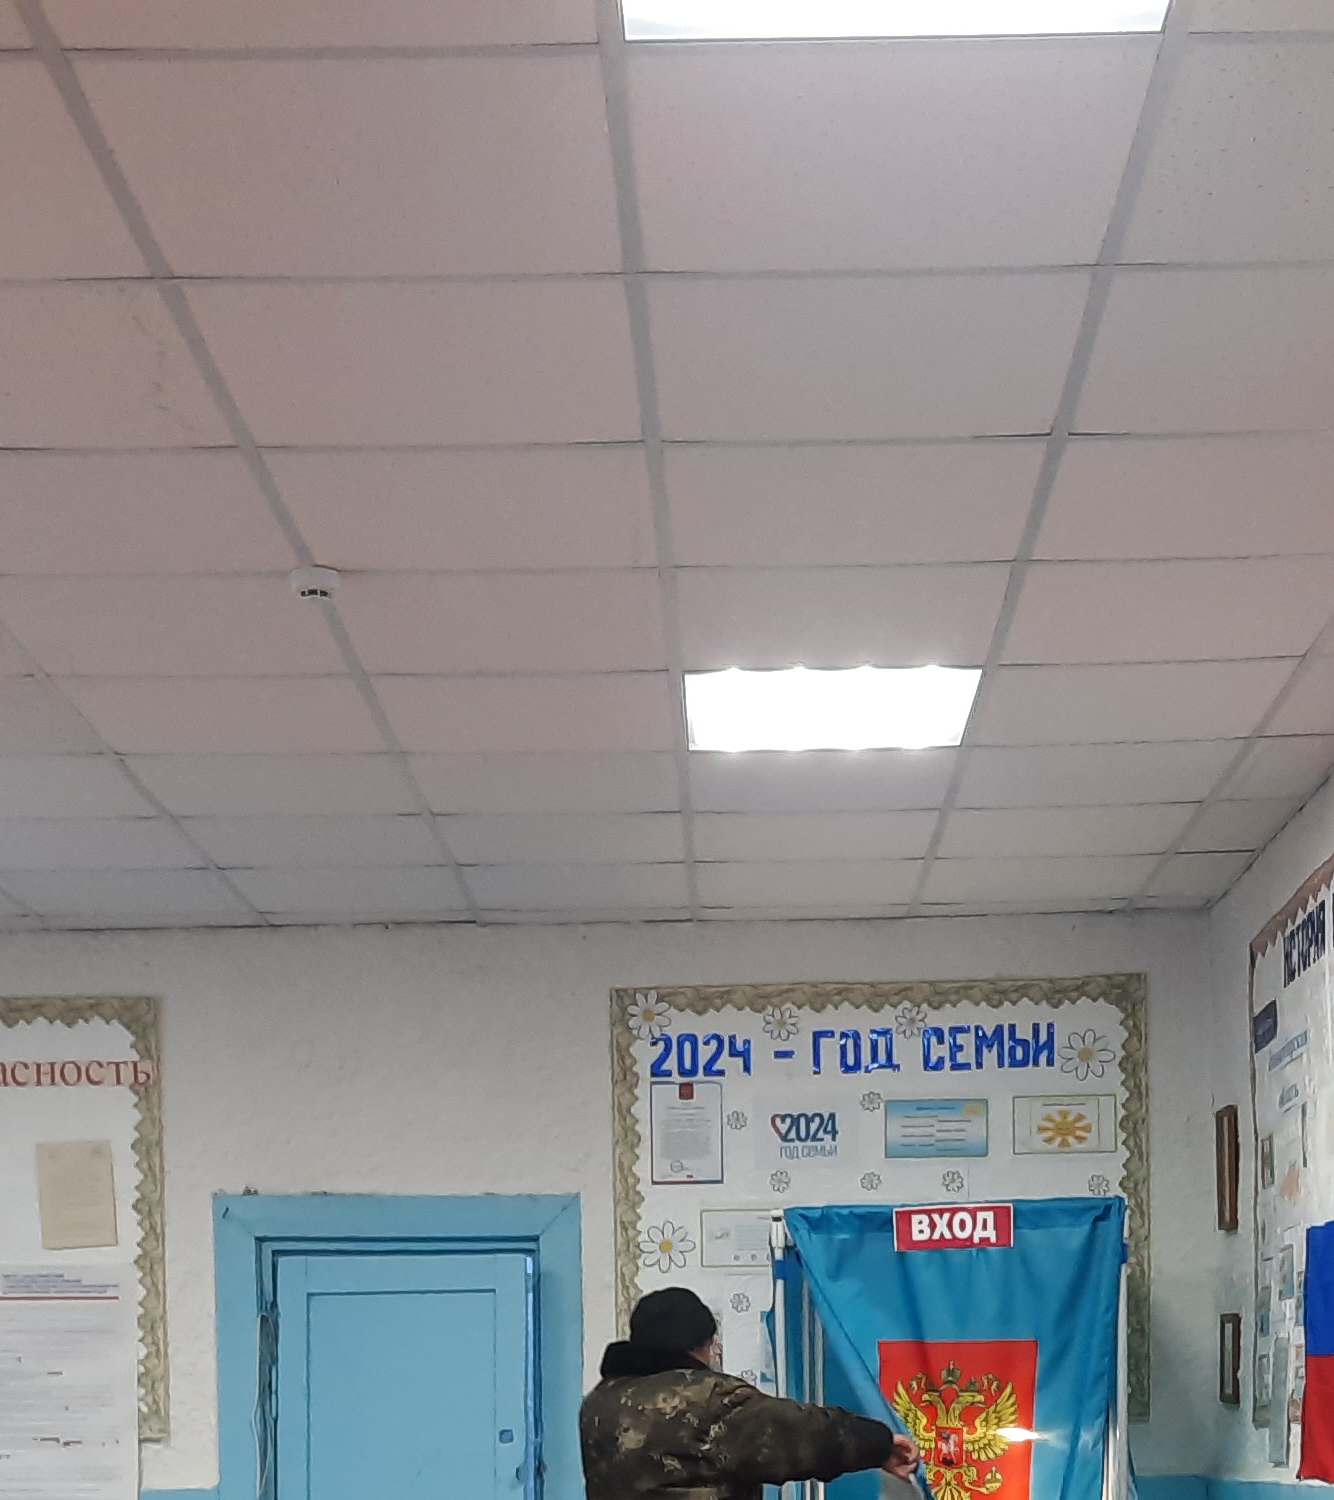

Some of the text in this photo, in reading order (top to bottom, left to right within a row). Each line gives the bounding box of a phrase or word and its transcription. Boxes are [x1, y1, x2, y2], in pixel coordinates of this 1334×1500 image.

[650, 1031, 752, 1078] 2024
[812, 1027, 901, 1076] ГОД
[922, 1021, 1056, 1072] СЕМЬИ
[779, 1112, 839, 1142] 2024
[910, 1211, 997, 1244] ВХОД
